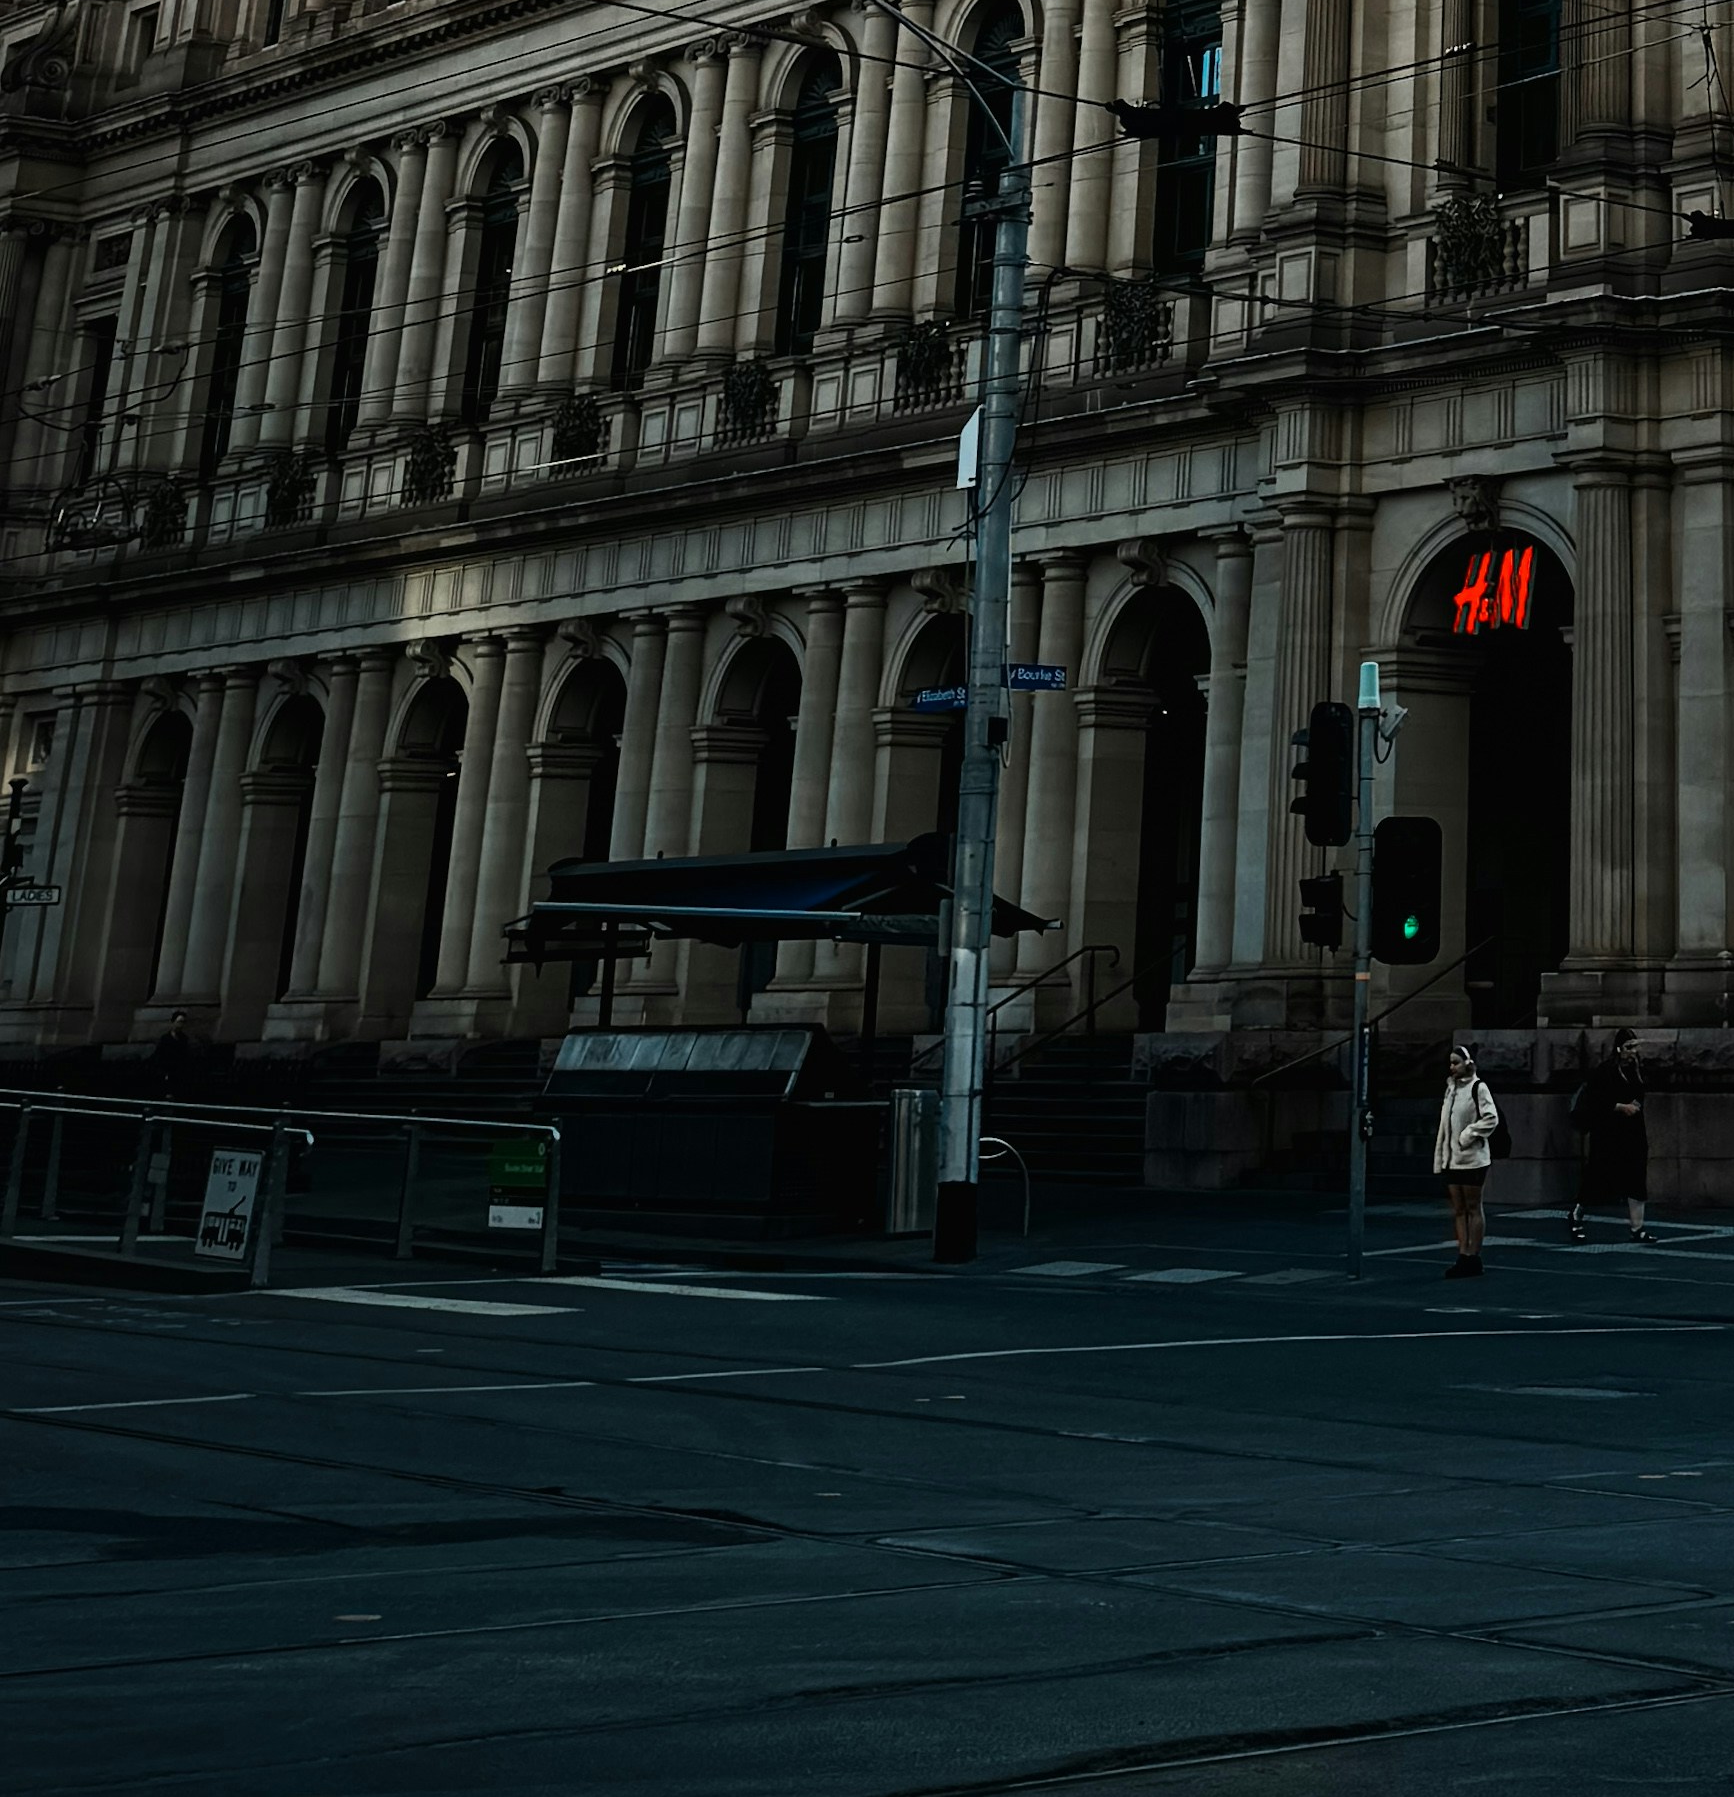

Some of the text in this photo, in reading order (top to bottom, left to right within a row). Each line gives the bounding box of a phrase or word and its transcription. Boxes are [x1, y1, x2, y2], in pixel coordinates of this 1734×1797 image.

[1452, 544, 1536, 636] H&M
[1017, 667, 1065, 682] Bourke St
[922, 686, 966, 702] Elizabeth St
[12, 889, 53, 902] LADIES
[213, 1157, 259, 1177] GIVE WAY
[227, 1180, 238, 1192] TO
